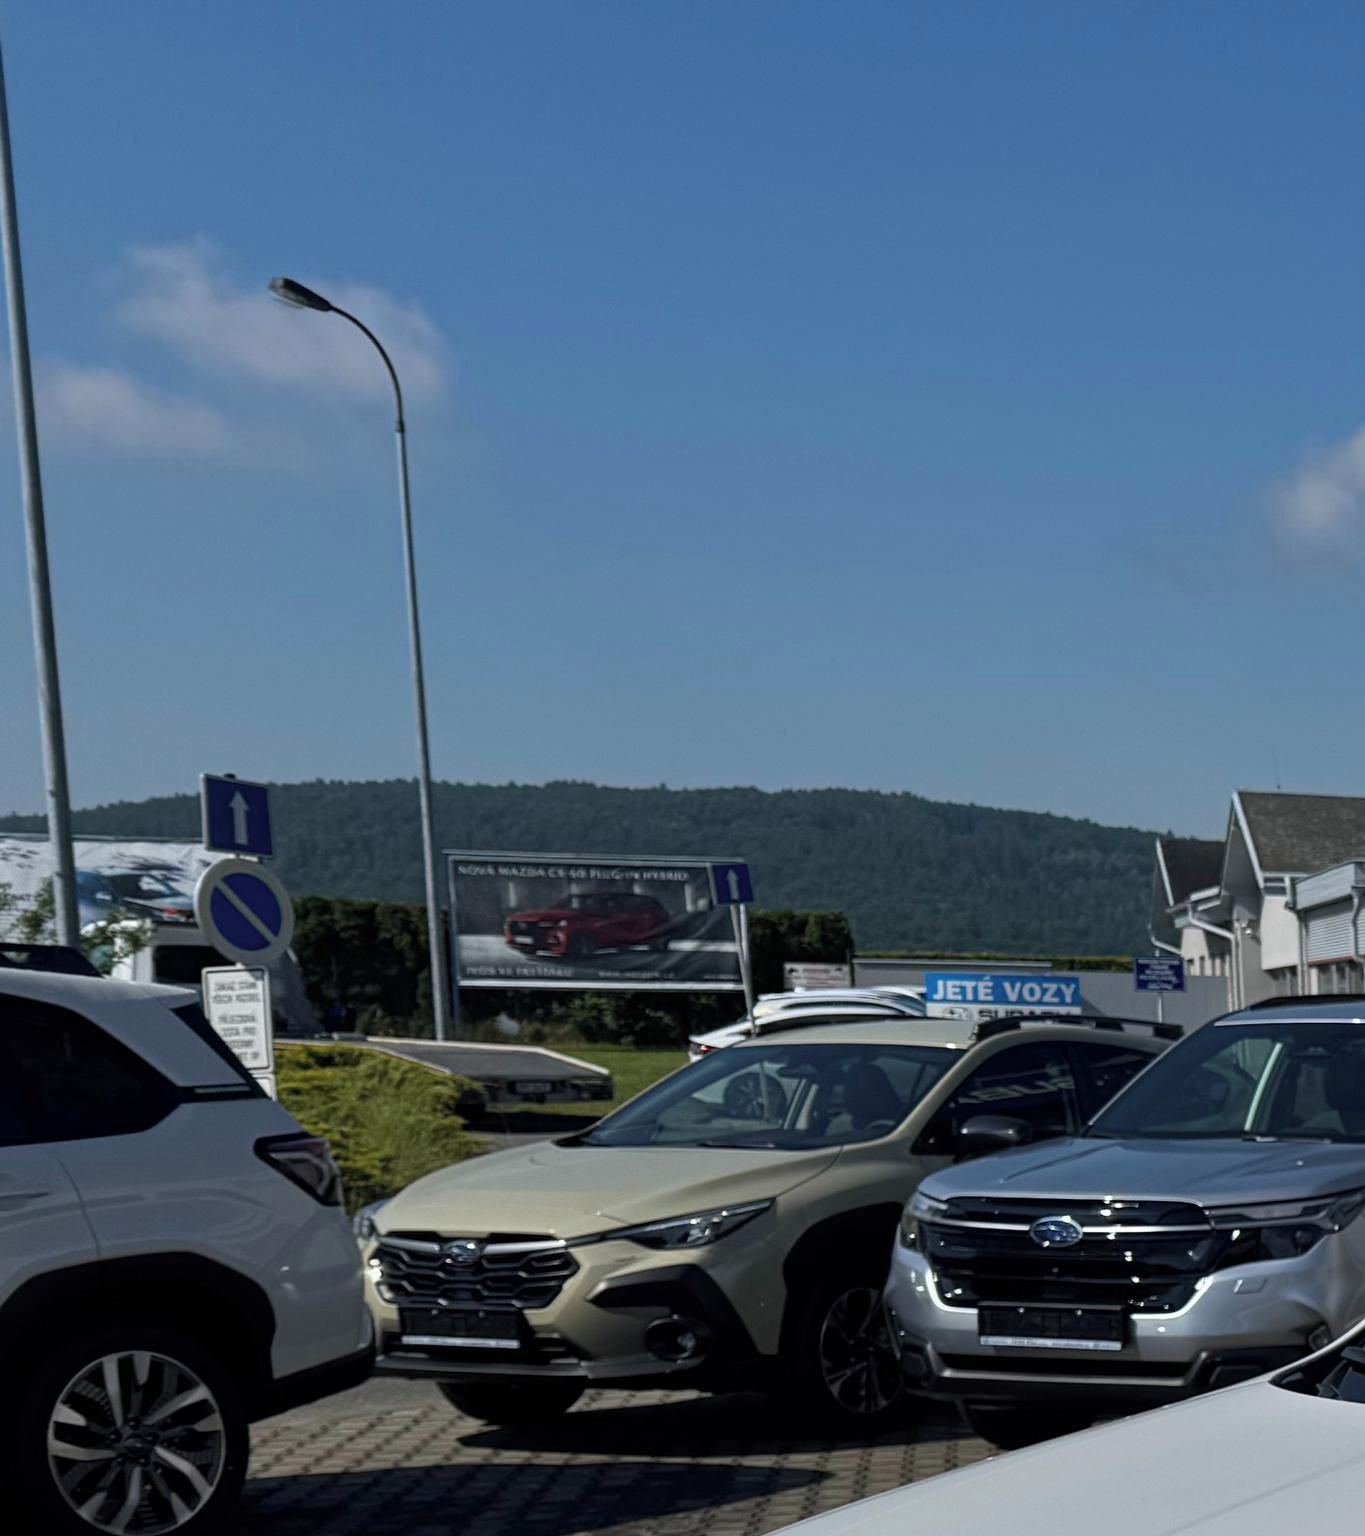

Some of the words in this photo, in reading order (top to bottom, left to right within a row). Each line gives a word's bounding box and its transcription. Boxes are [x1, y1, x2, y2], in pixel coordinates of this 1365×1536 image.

[498, 866, 545, 878] MAZDA
[932, 976, 994, 1001] JETÉ
[1002, 981, 1076, 1004] VOZY
